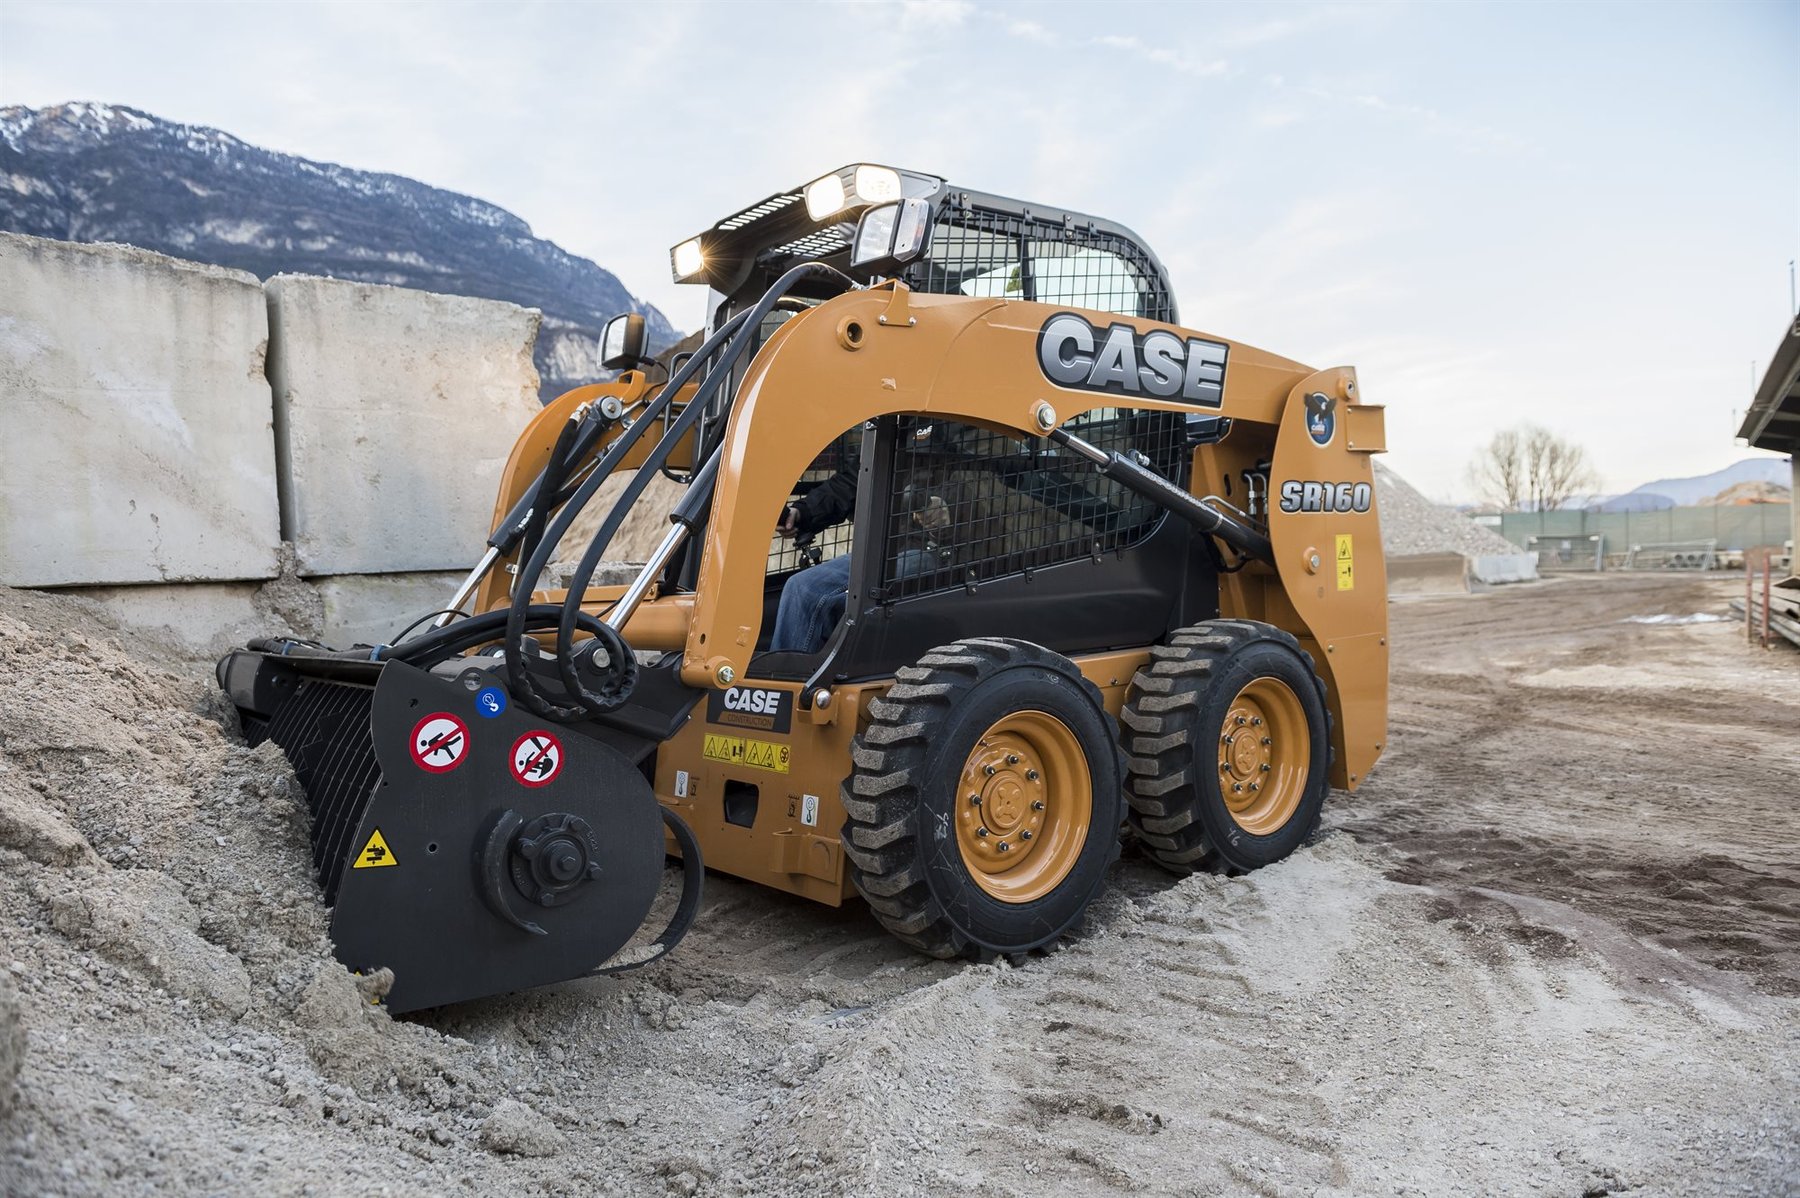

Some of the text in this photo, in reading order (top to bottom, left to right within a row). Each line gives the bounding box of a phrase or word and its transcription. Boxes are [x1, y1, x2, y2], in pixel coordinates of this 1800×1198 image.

[1040, 314, 1229, 404] CASE
[1280, 480, 1372, 513] SR160
[724, 687, 781, 715] CASE
